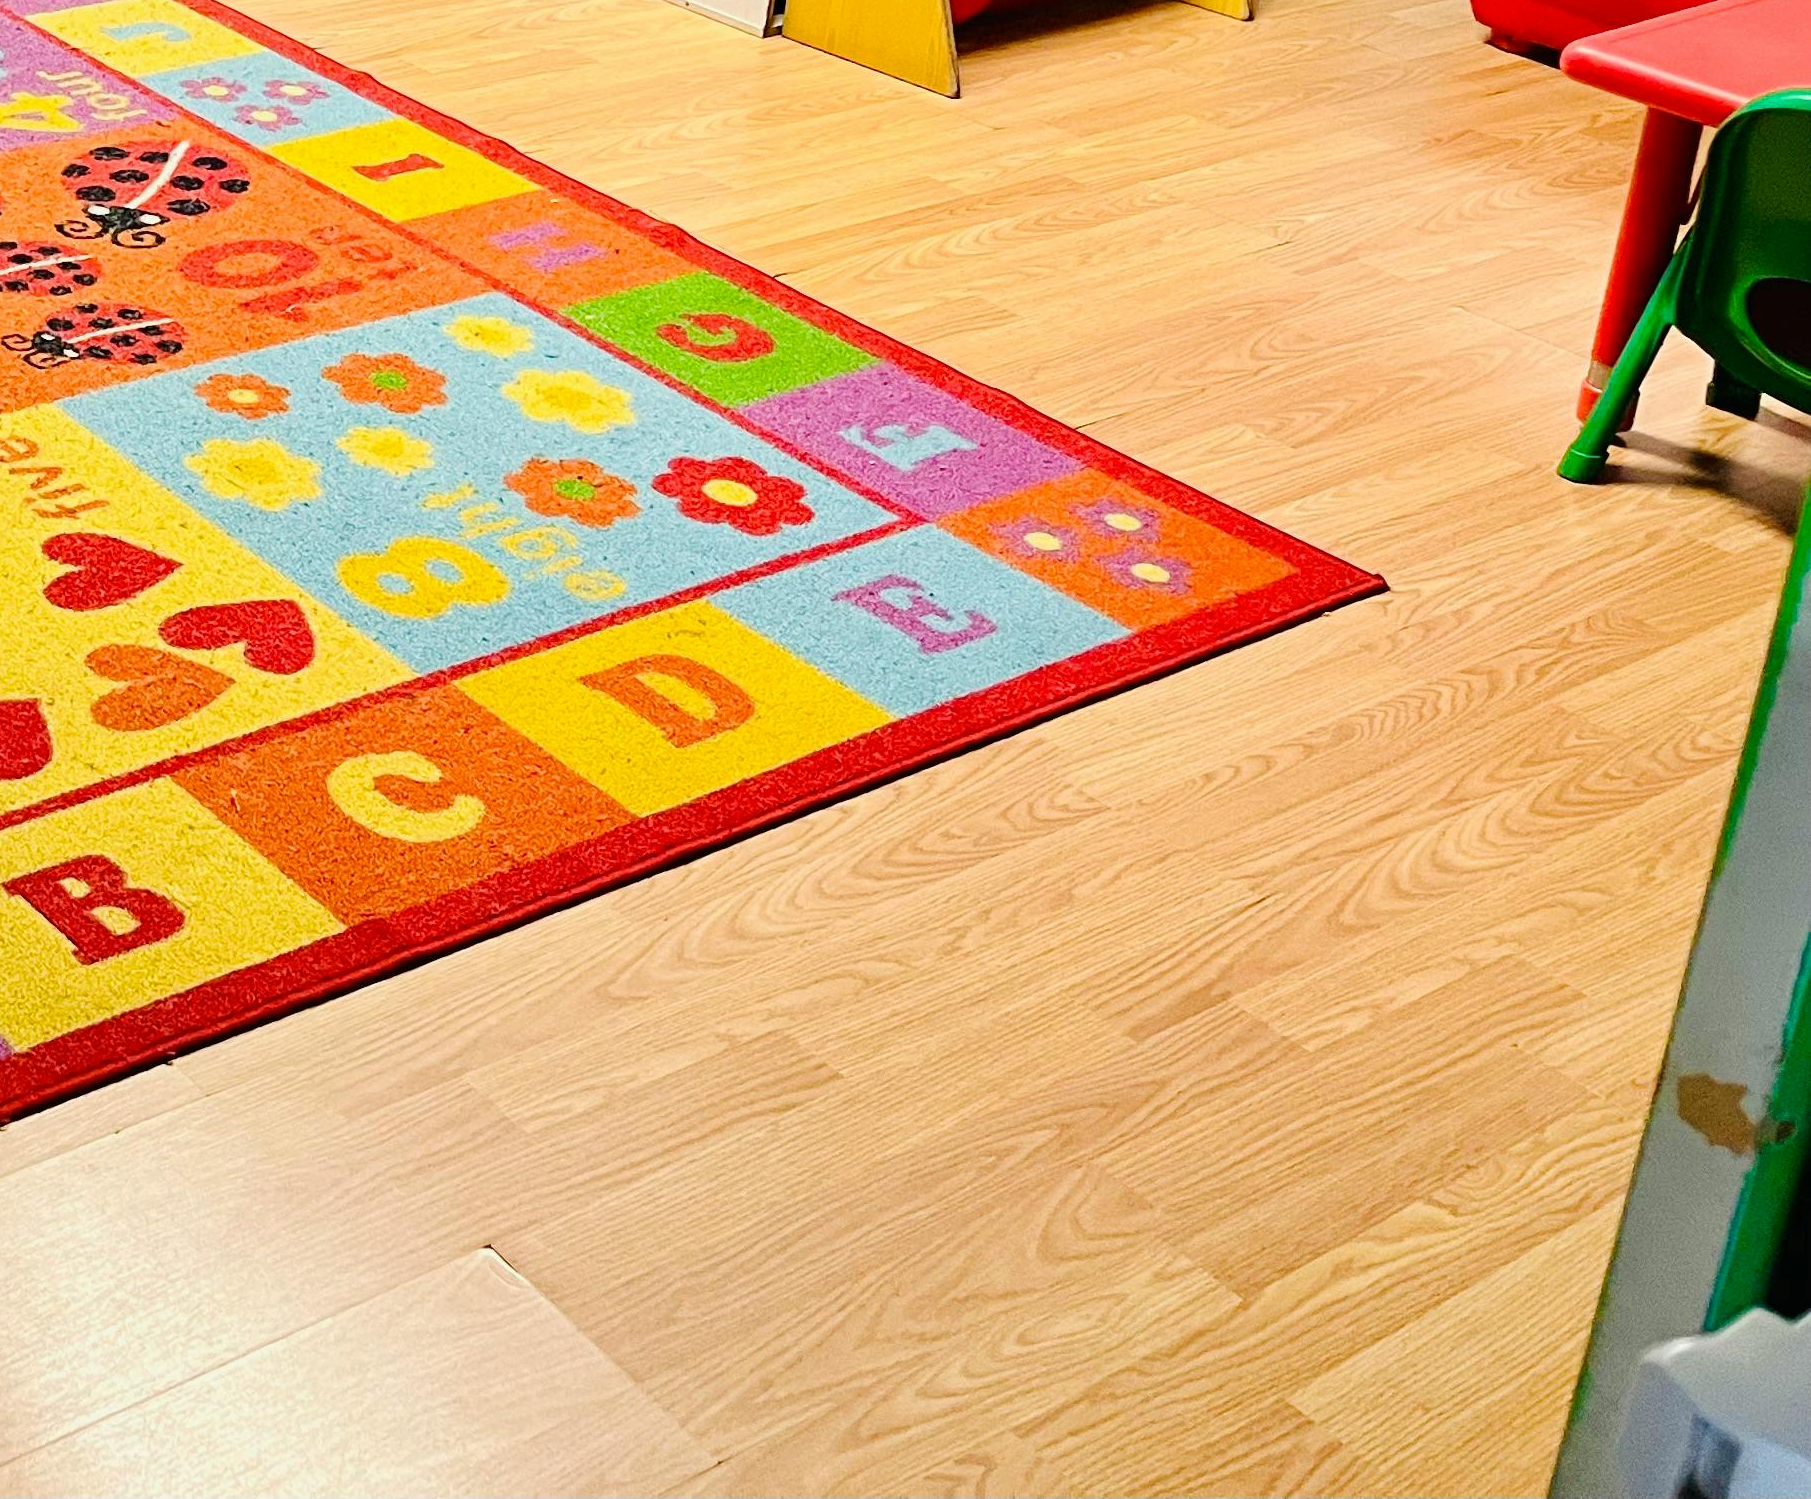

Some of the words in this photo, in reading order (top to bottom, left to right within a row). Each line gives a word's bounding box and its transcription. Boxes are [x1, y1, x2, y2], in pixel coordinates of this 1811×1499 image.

[35, 70, 148, 121] four
[353, 153, 444, 181] I
[177, 238, 365, 322] 10
[489, 220, 607, 273] H
[655, 311, 776, 363] G
[836, 420, 977, 472] F
[336, 535, 512, 620] 8
[422, 483, 627, 601] eight
[830, 573, 998, 655] E
[578, 652, 757, 749] D
[325, 750, 487, 844] C
[2, 853, 185, 966] B
